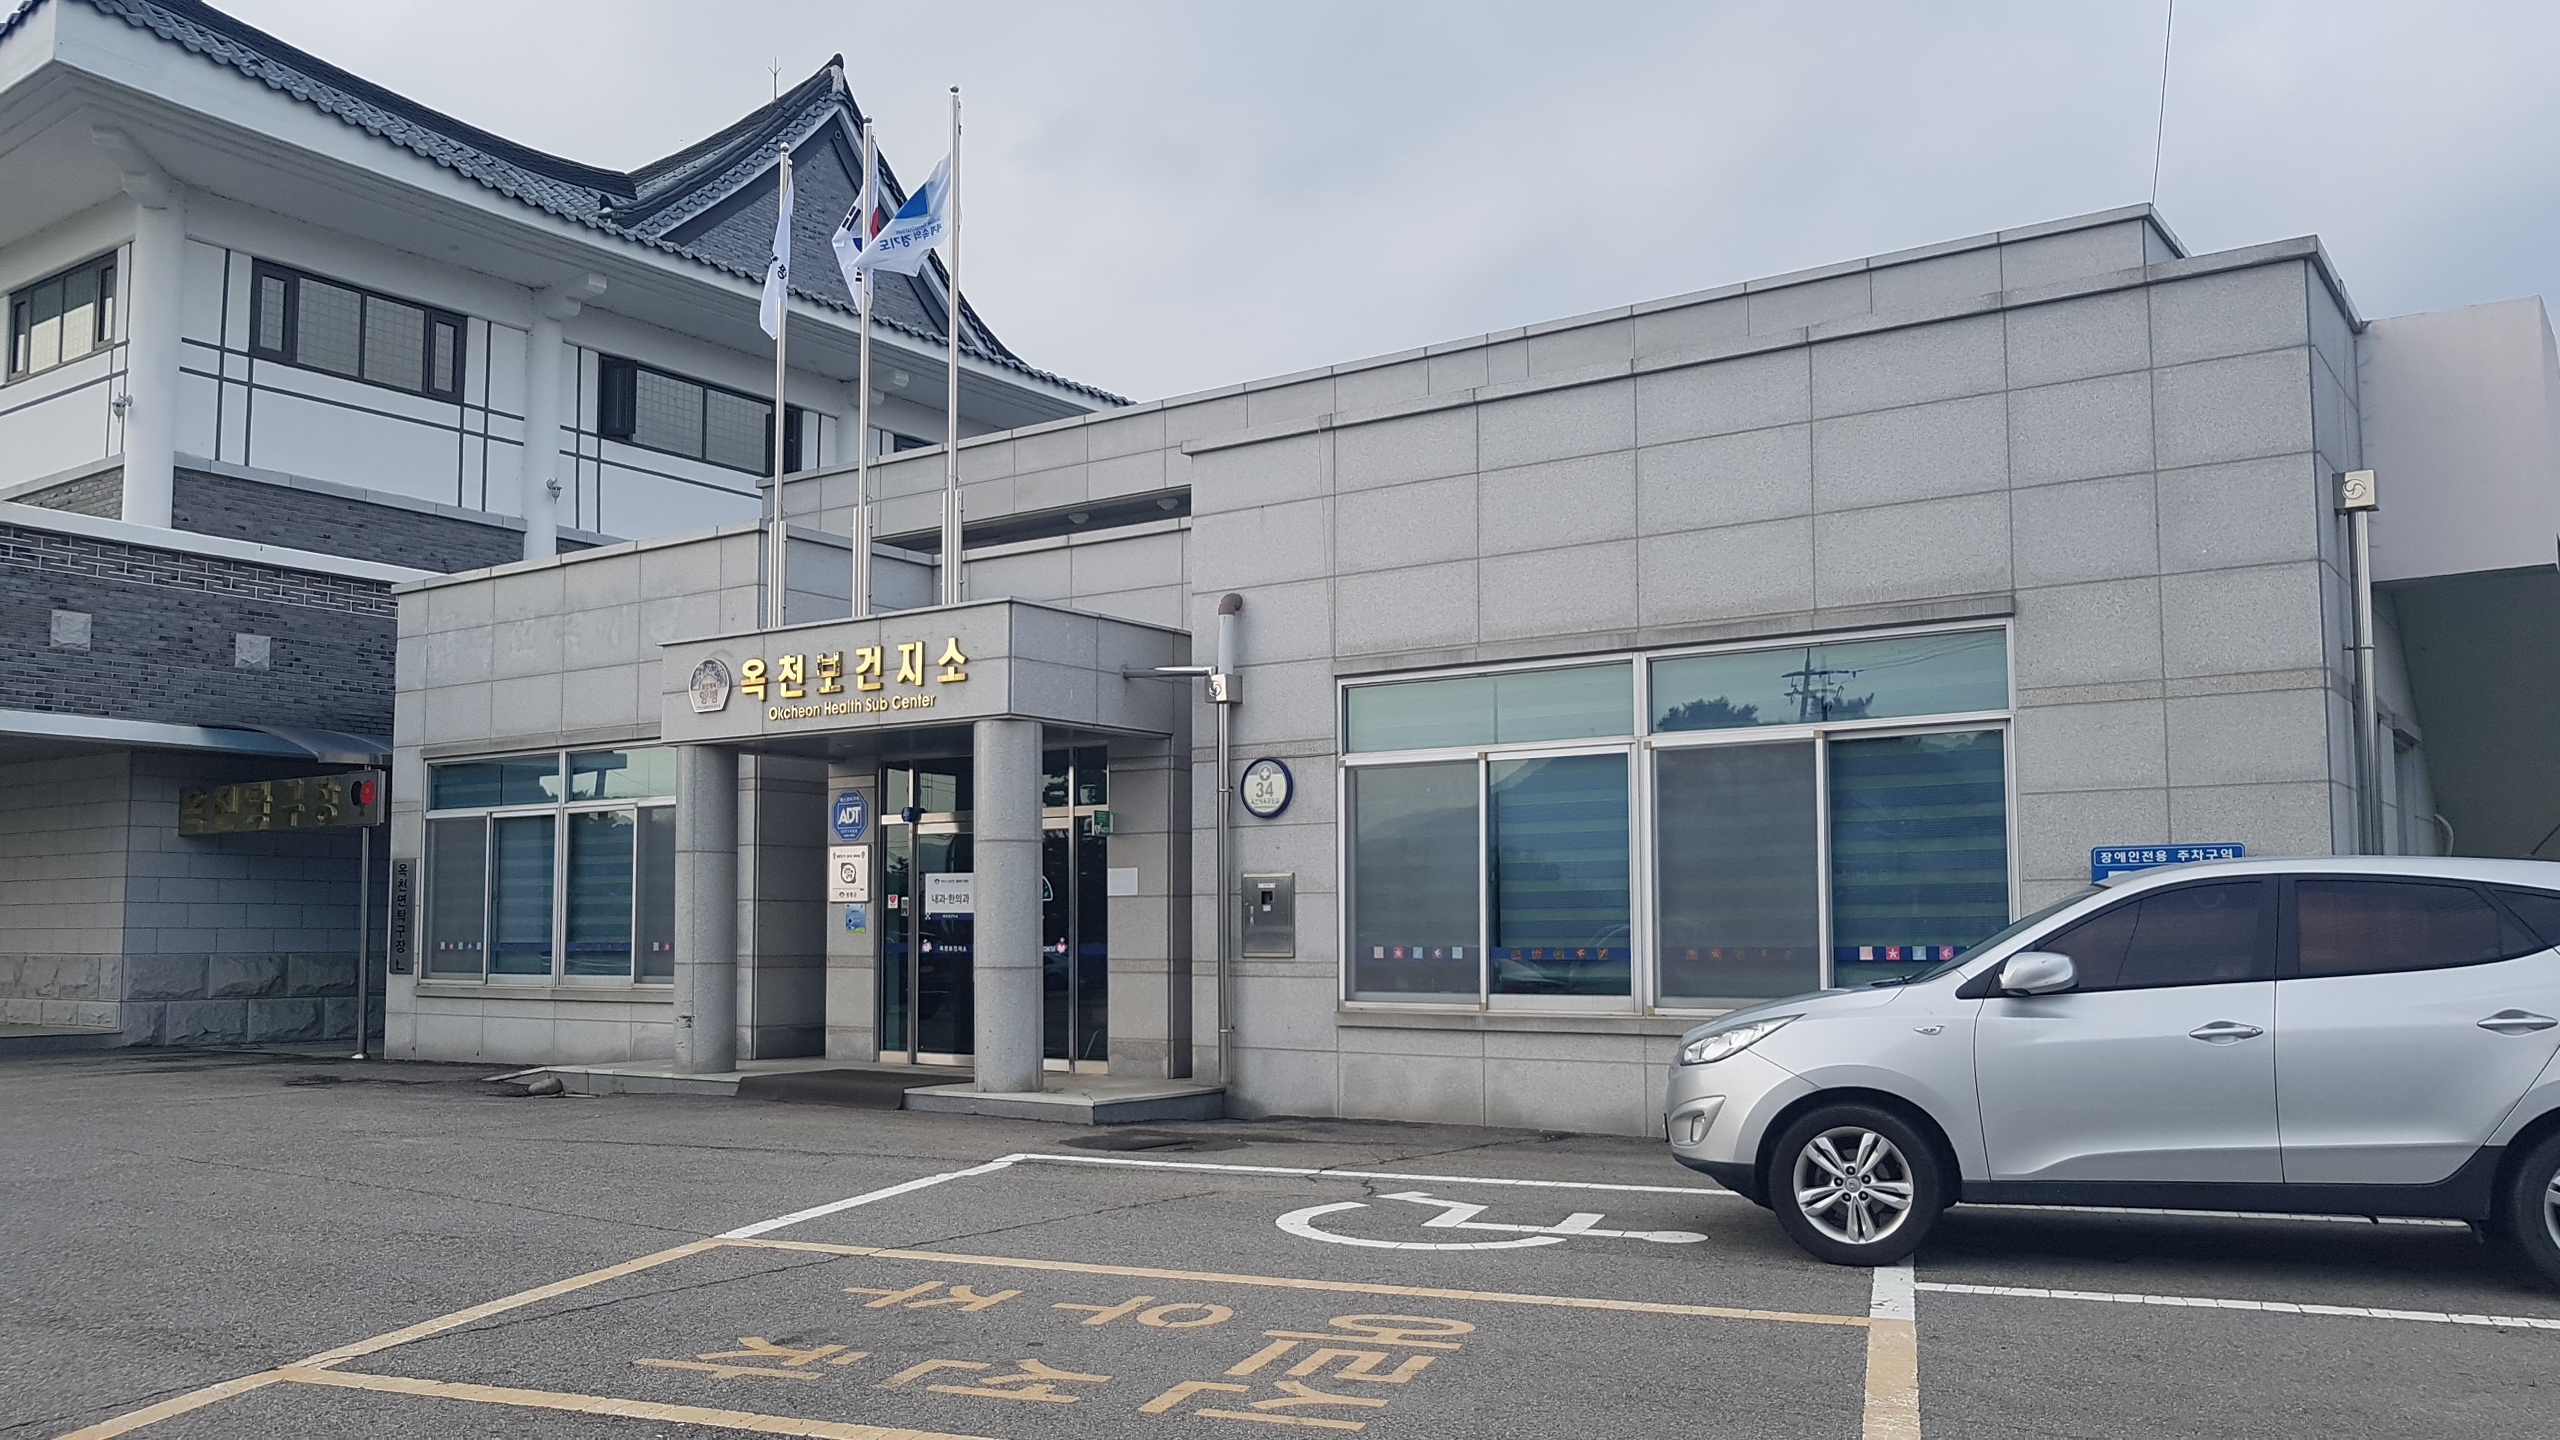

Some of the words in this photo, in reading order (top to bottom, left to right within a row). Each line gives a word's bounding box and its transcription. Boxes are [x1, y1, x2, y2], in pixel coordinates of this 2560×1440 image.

[741, 637, 969, 701] 옥천보건지소
[768, 705, 821, 721] Okcheon
[824, 701, 863, 716] Health
[865, 697, 889, 713] Sub
[892, 694, 937, 710] Center
[1256, 781, 1274, 798] 34
[838, 806, 861, 825] ADT
[2100, 849, 2168, 864] 장애인전용
[2177, 848, 2234, 862] 주차구역
[395, 863, 409, 954] 옥천면탁구장
